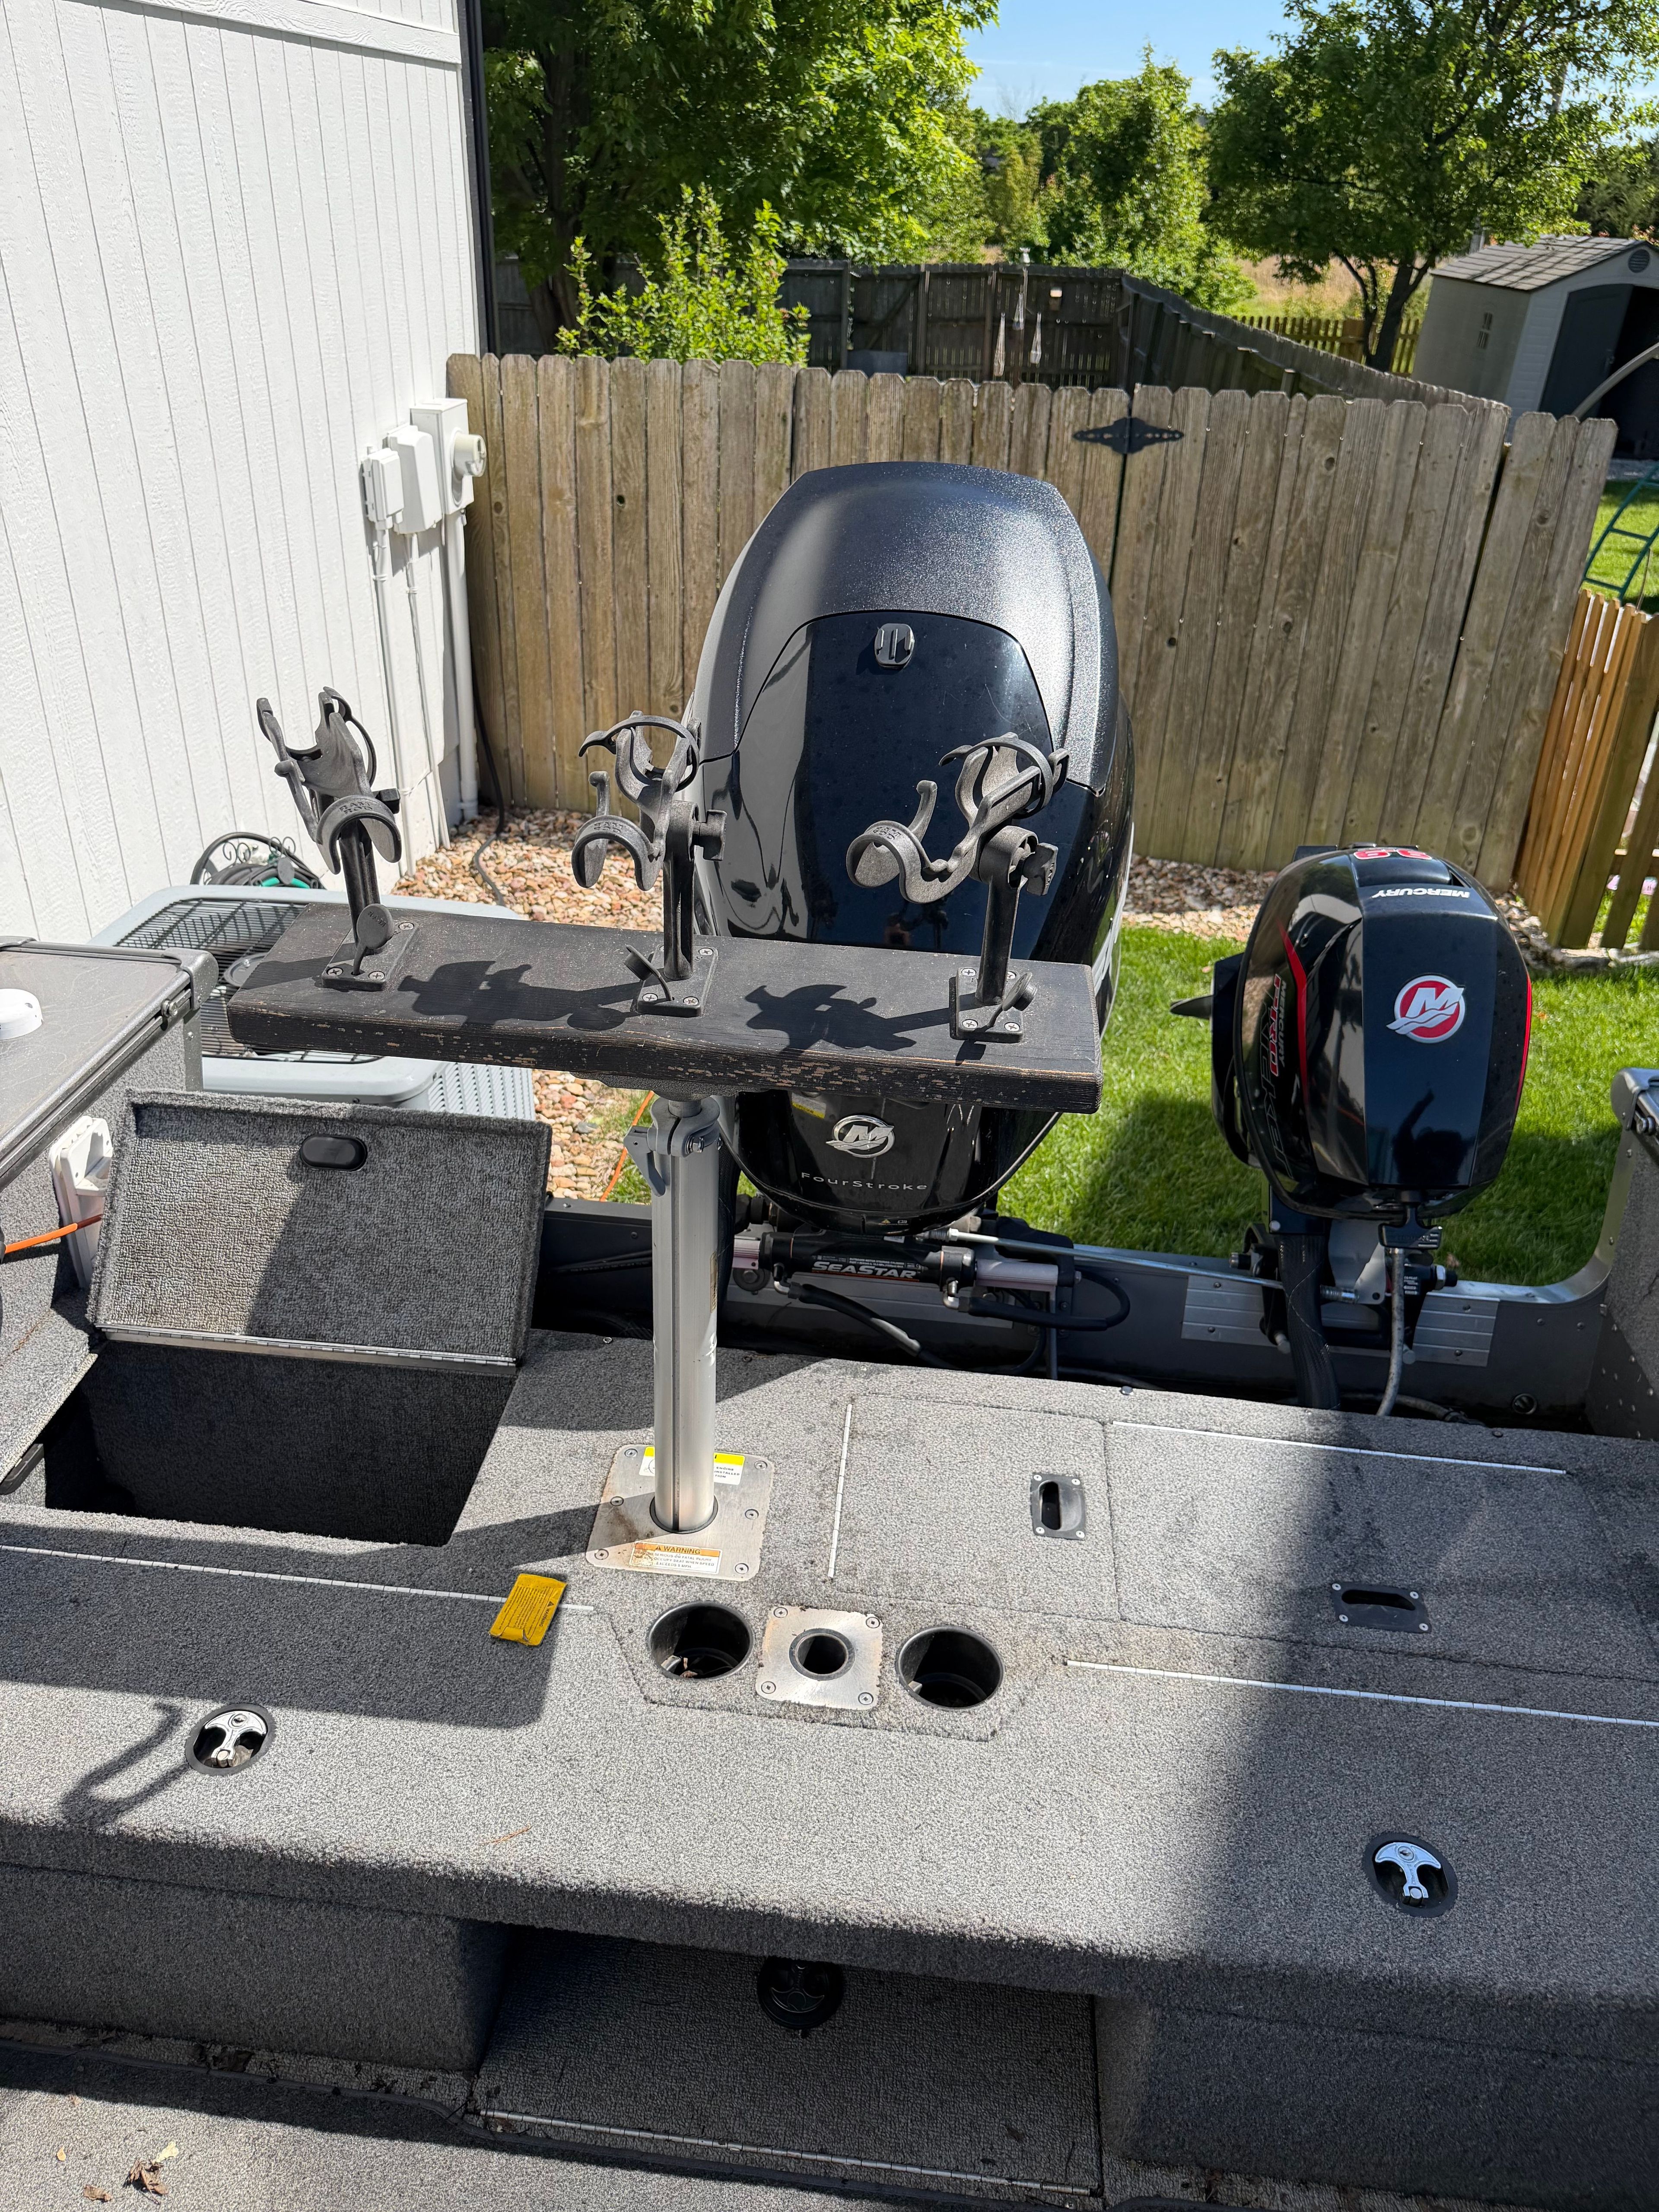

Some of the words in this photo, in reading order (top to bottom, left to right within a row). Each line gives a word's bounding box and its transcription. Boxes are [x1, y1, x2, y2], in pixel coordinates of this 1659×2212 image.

[1370, 887, 1470, 899] MERCURY
[1269, 973, 1281, 1077] PRO
[1278, 979, 1287, 1068] MERCURY
[801, 1172, 928, 1190] FourStroke
[664, 1545, 700, 1554] WARNING
[539, 1608, 551, 1627] WARNING
